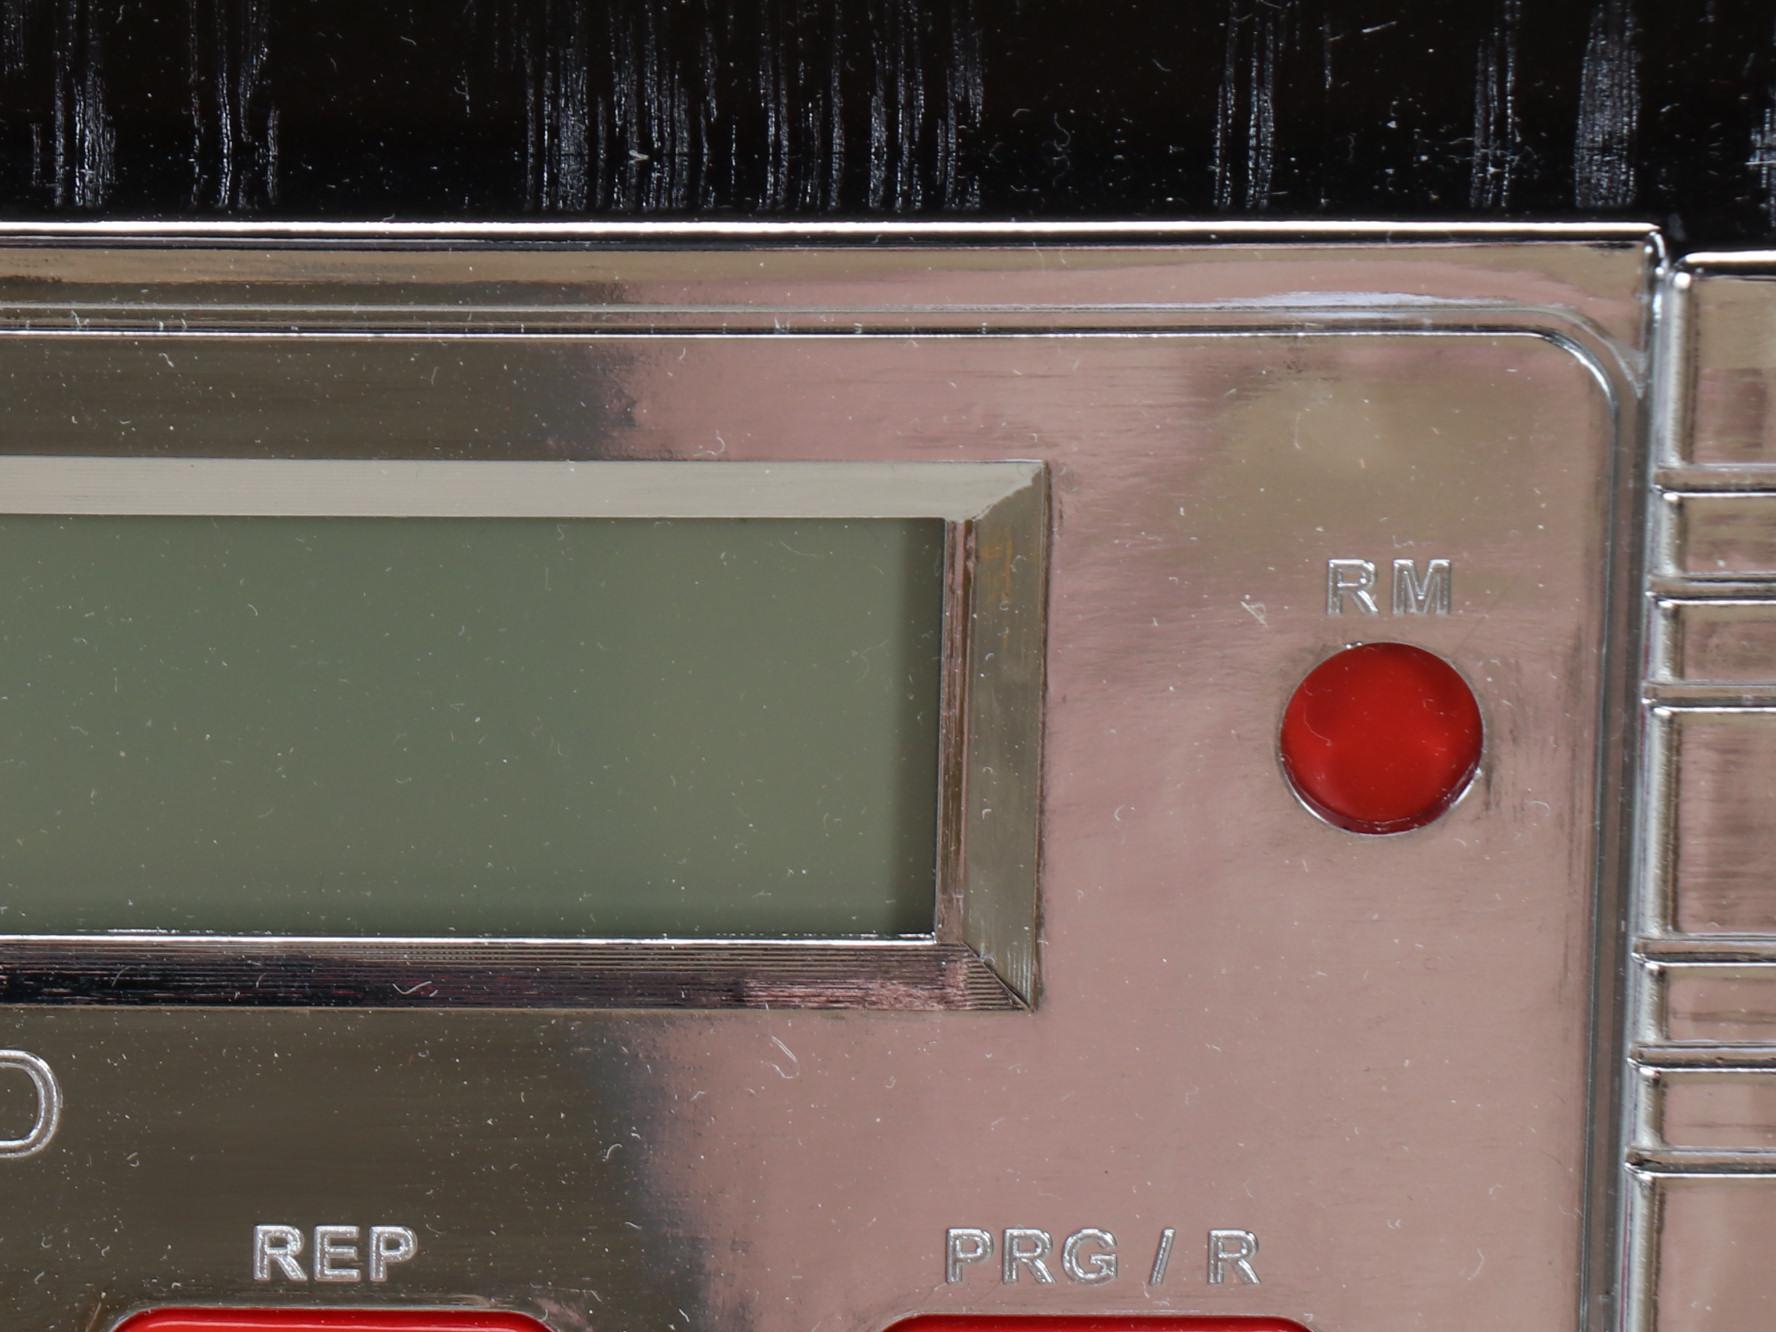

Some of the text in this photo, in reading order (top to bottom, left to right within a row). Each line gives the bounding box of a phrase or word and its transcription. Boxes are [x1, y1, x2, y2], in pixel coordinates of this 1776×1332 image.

[1327, 558, 1453, 616] RM
[252, 1224, 419, 1282] REP
[945, 1227, 1262, 1286] PRG / R
